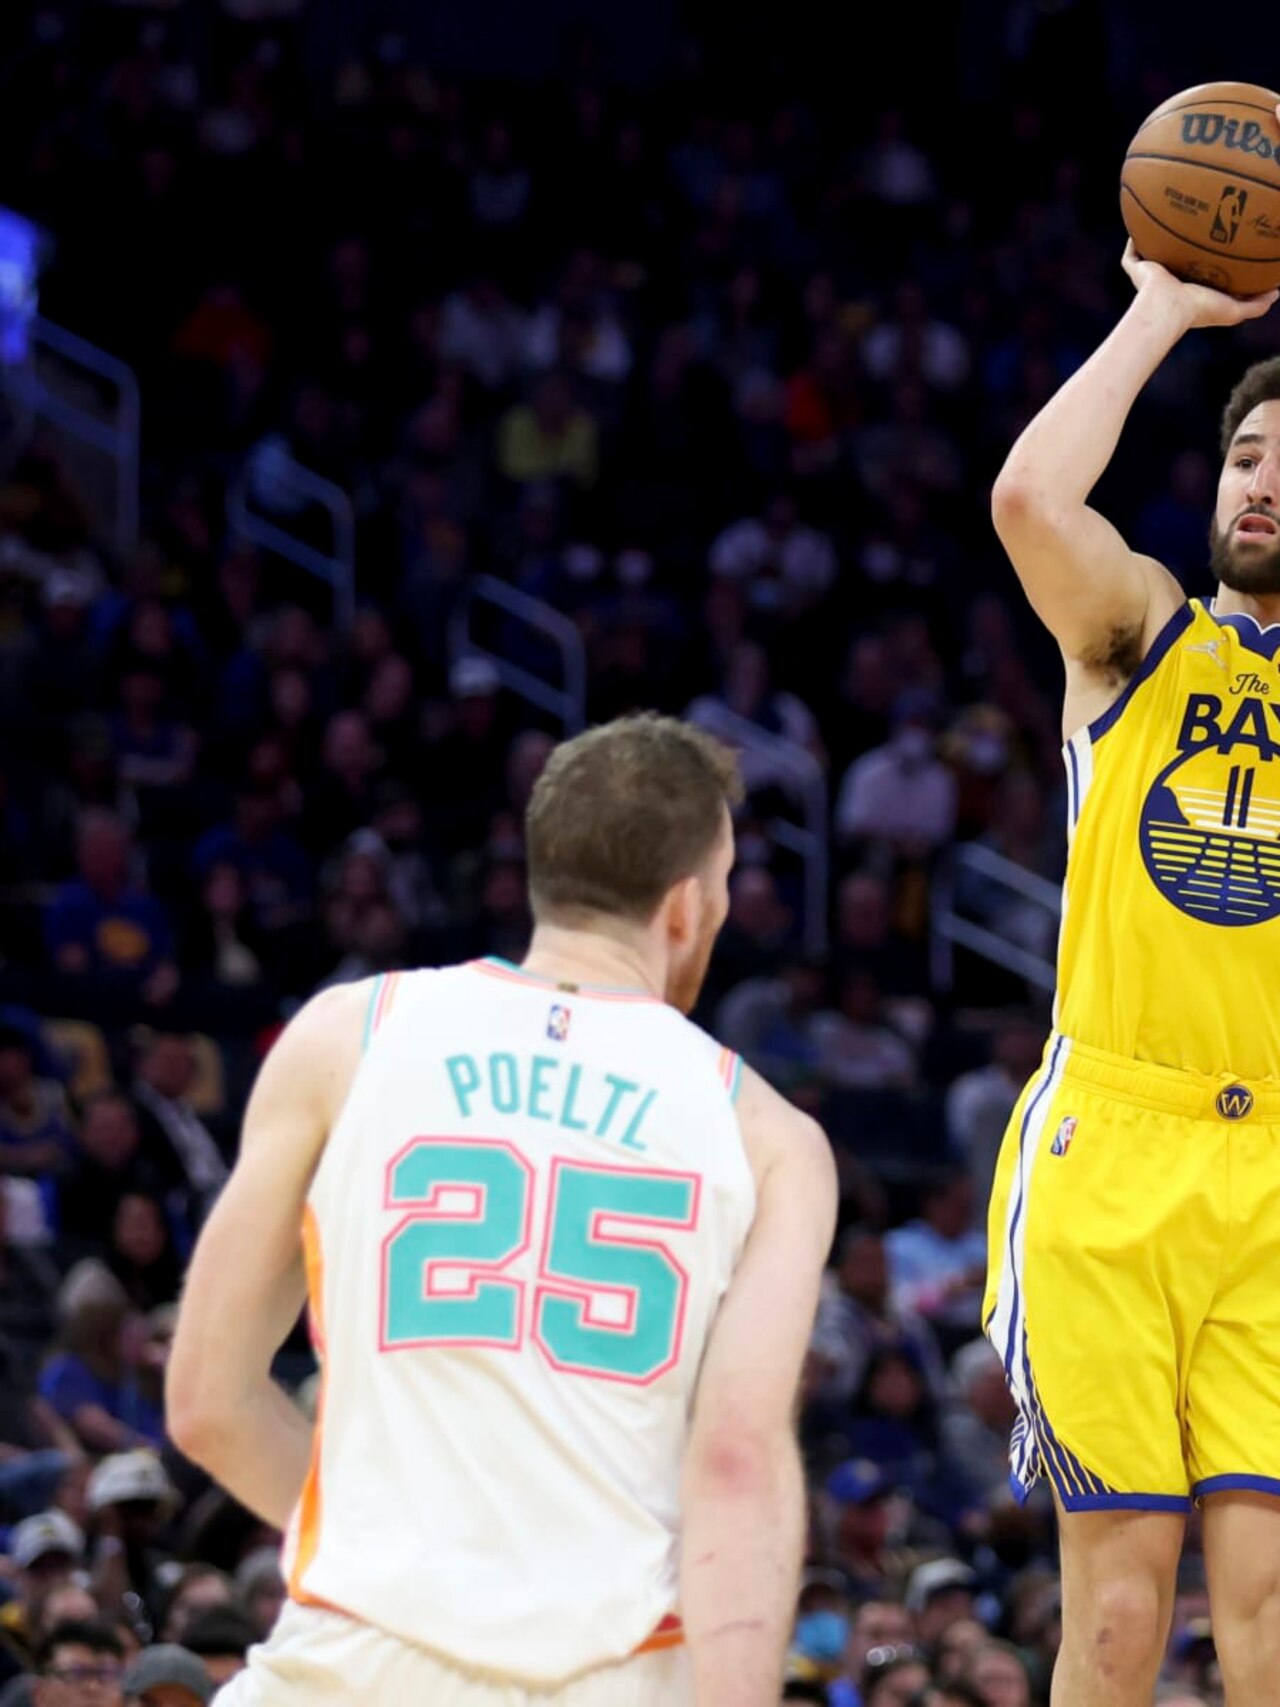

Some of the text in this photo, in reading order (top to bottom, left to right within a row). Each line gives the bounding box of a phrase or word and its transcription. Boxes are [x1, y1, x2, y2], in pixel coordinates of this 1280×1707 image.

[1229, 672, 1271, 695] The
[1222, 764, 1255, 829] 11
[445, 1051, 658, 1151] POELTL
[378, 1135, 703, 1387] 25
